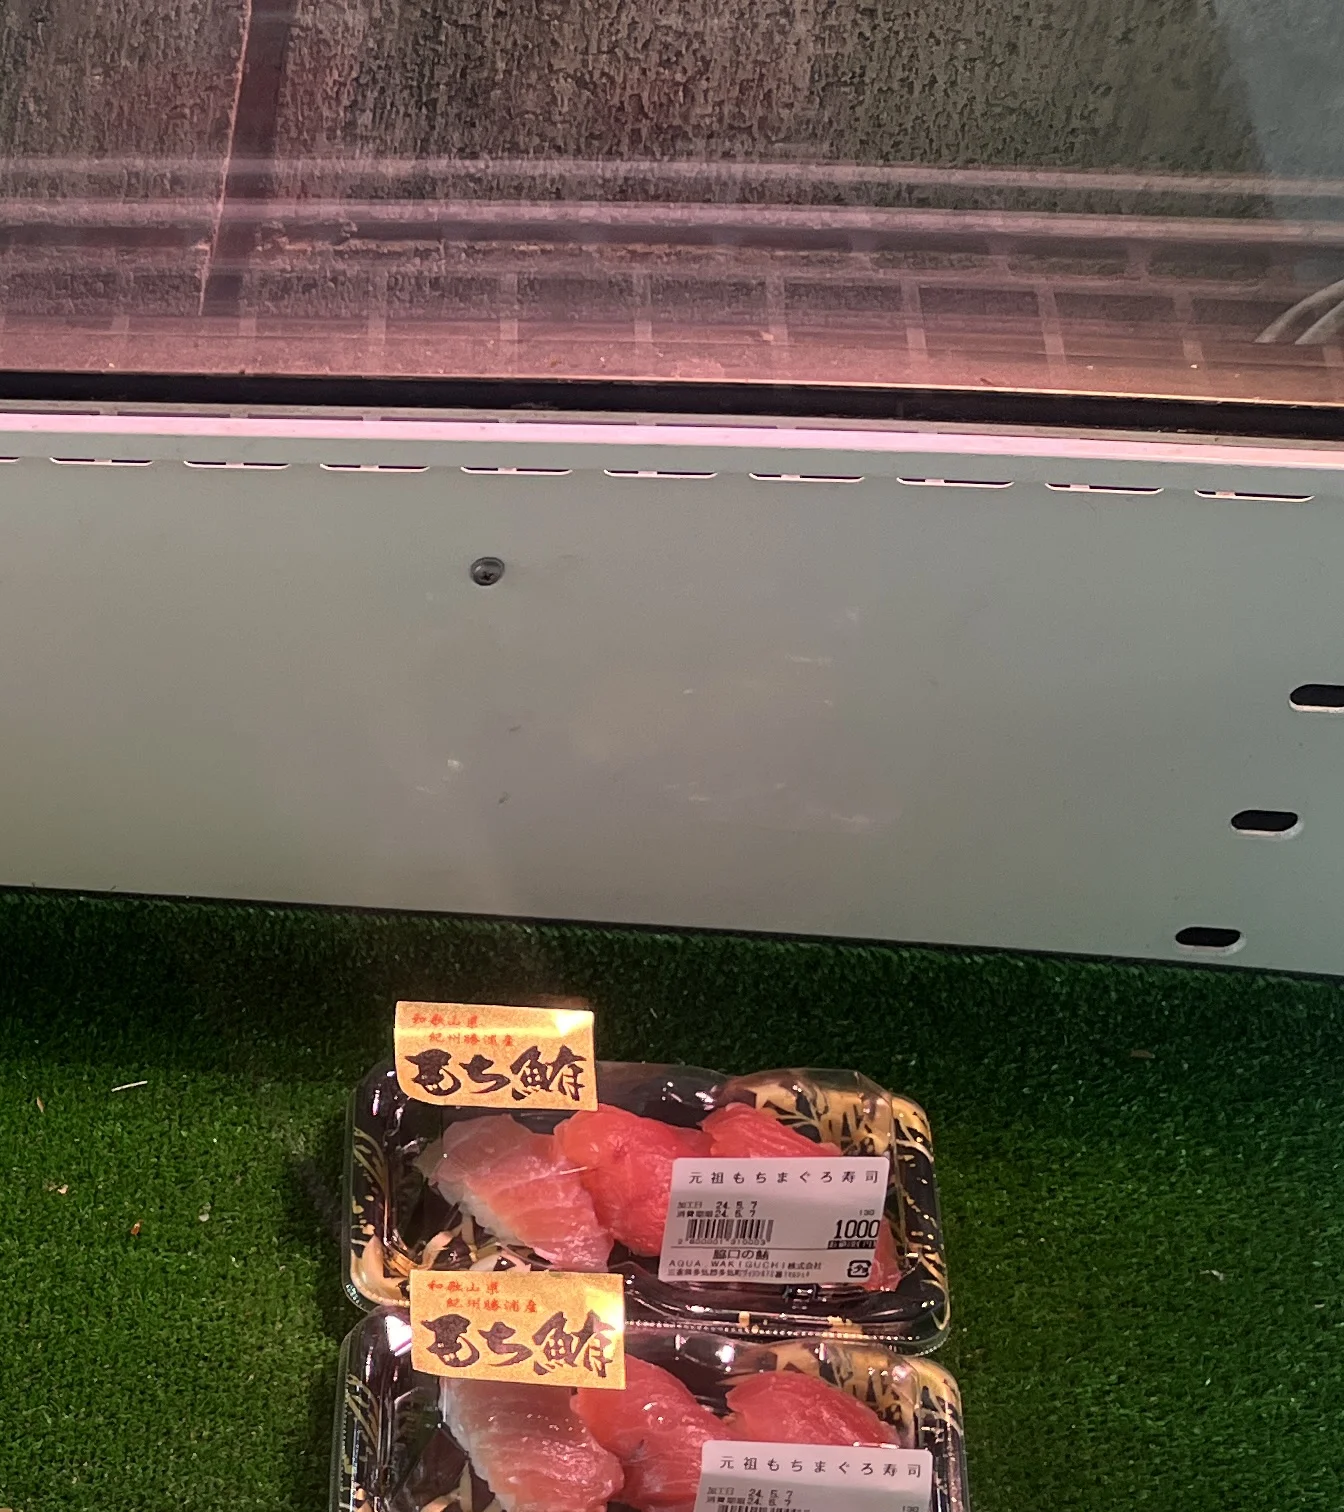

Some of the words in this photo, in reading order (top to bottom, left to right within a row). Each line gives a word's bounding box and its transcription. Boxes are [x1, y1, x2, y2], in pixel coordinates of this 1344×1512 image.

[411, 1012, 478, 1028] 和歌山県
[688, 1170, 879, 1185] 元祖もちまぐろ寿司
[833, 1218, 880, 1239] 1000
[427, 1280, 499, 1294] 和歌山県
[719, 1454, 922, 1478] 元祖もちまぐろ寿司
